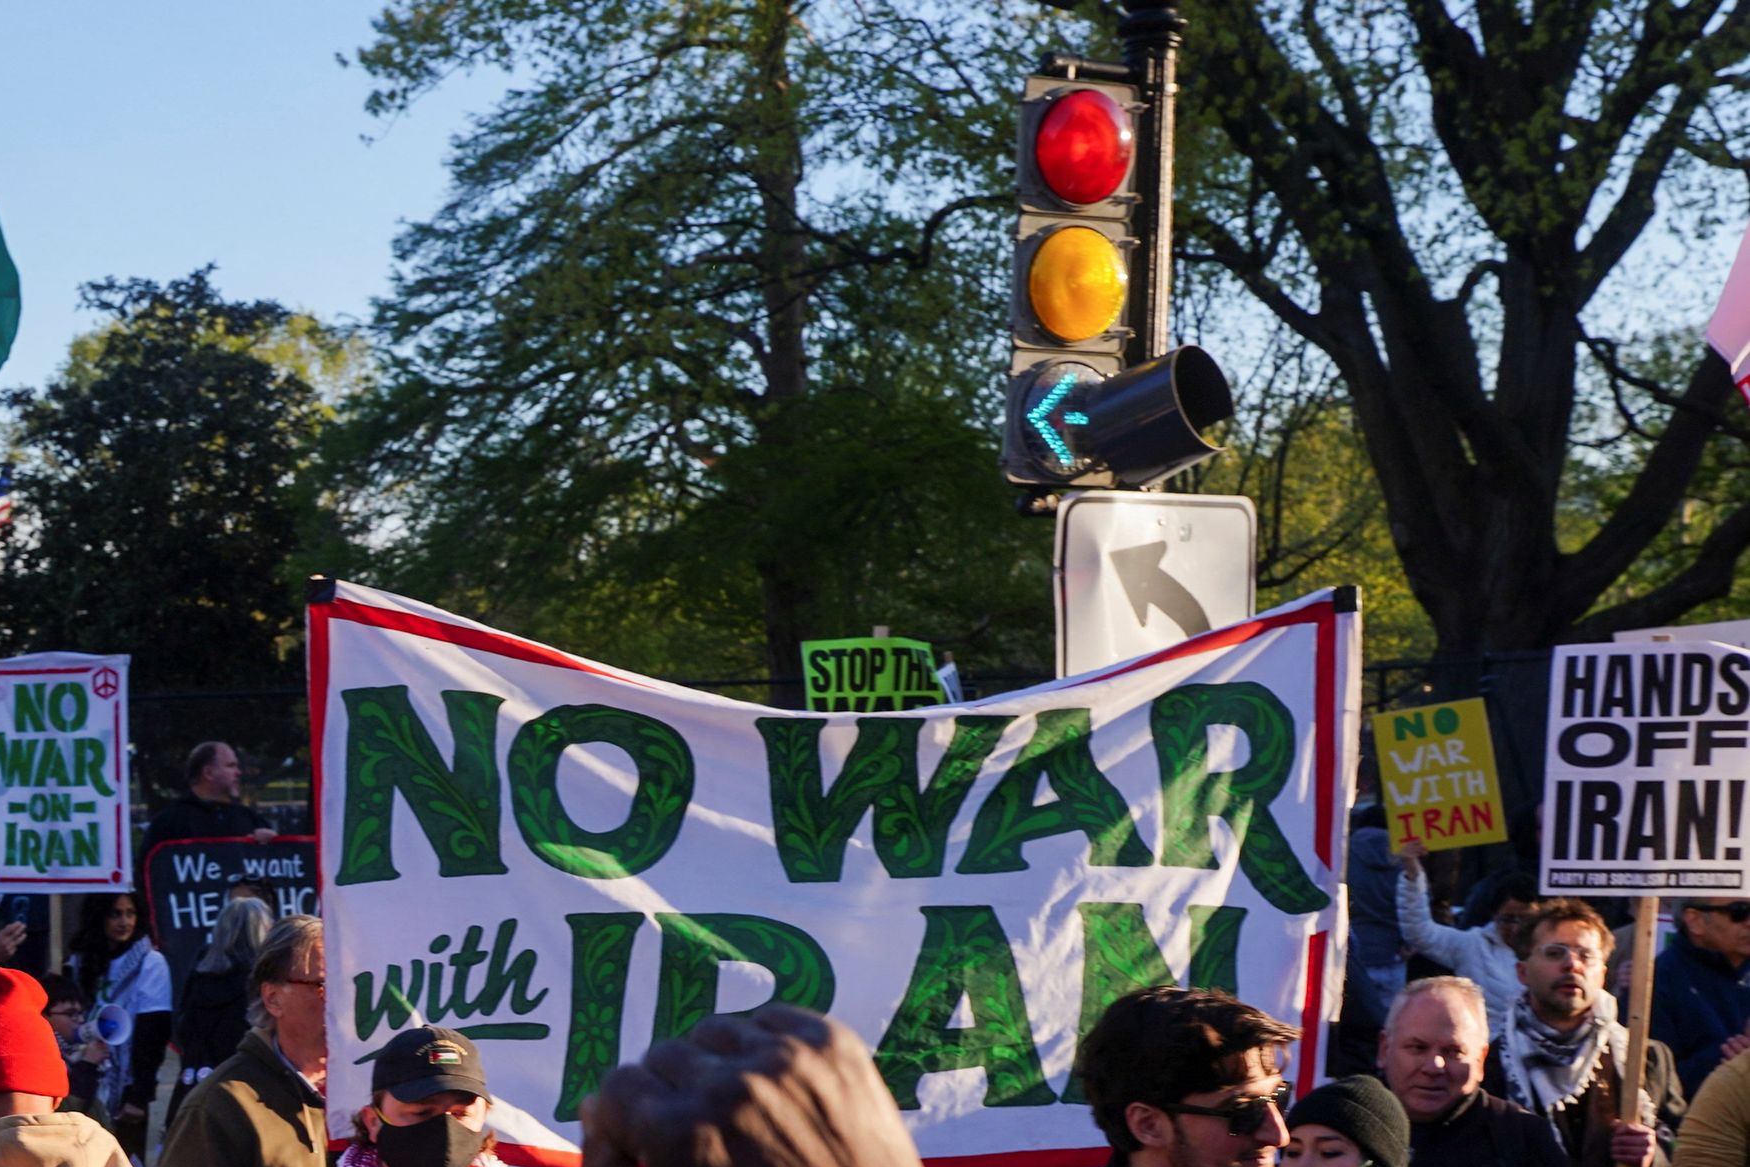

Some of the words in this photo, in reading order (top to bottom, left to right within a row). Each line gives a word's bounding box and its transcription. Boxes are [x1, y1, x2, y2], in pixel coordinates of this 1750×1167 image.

[810, 648, 887, 692] STOP
[891, 648, 940, 691] THE
[1561, 653, 1750, 717] HANDS
[14, 681, 88, 733] NO
[1394, 707, 1459, 741] NO
[1388, 739, 1471, 774] WAR
[1557, 720, 1749, 768] OFF
[335, 685, 695, 886] NO
[755, 681, 1331, 914] WAR
[1386, 769, 1487, 806] WITH
[1397, 801, 1494, 843] IRAN
[1552, 780, 1746, 860] IRAN!
[4, 822, 101, 873] IRAN
[173, 852, 223, 883] We
[243, 853, 305, 879] want
[353, 917, 549, 1042] with
